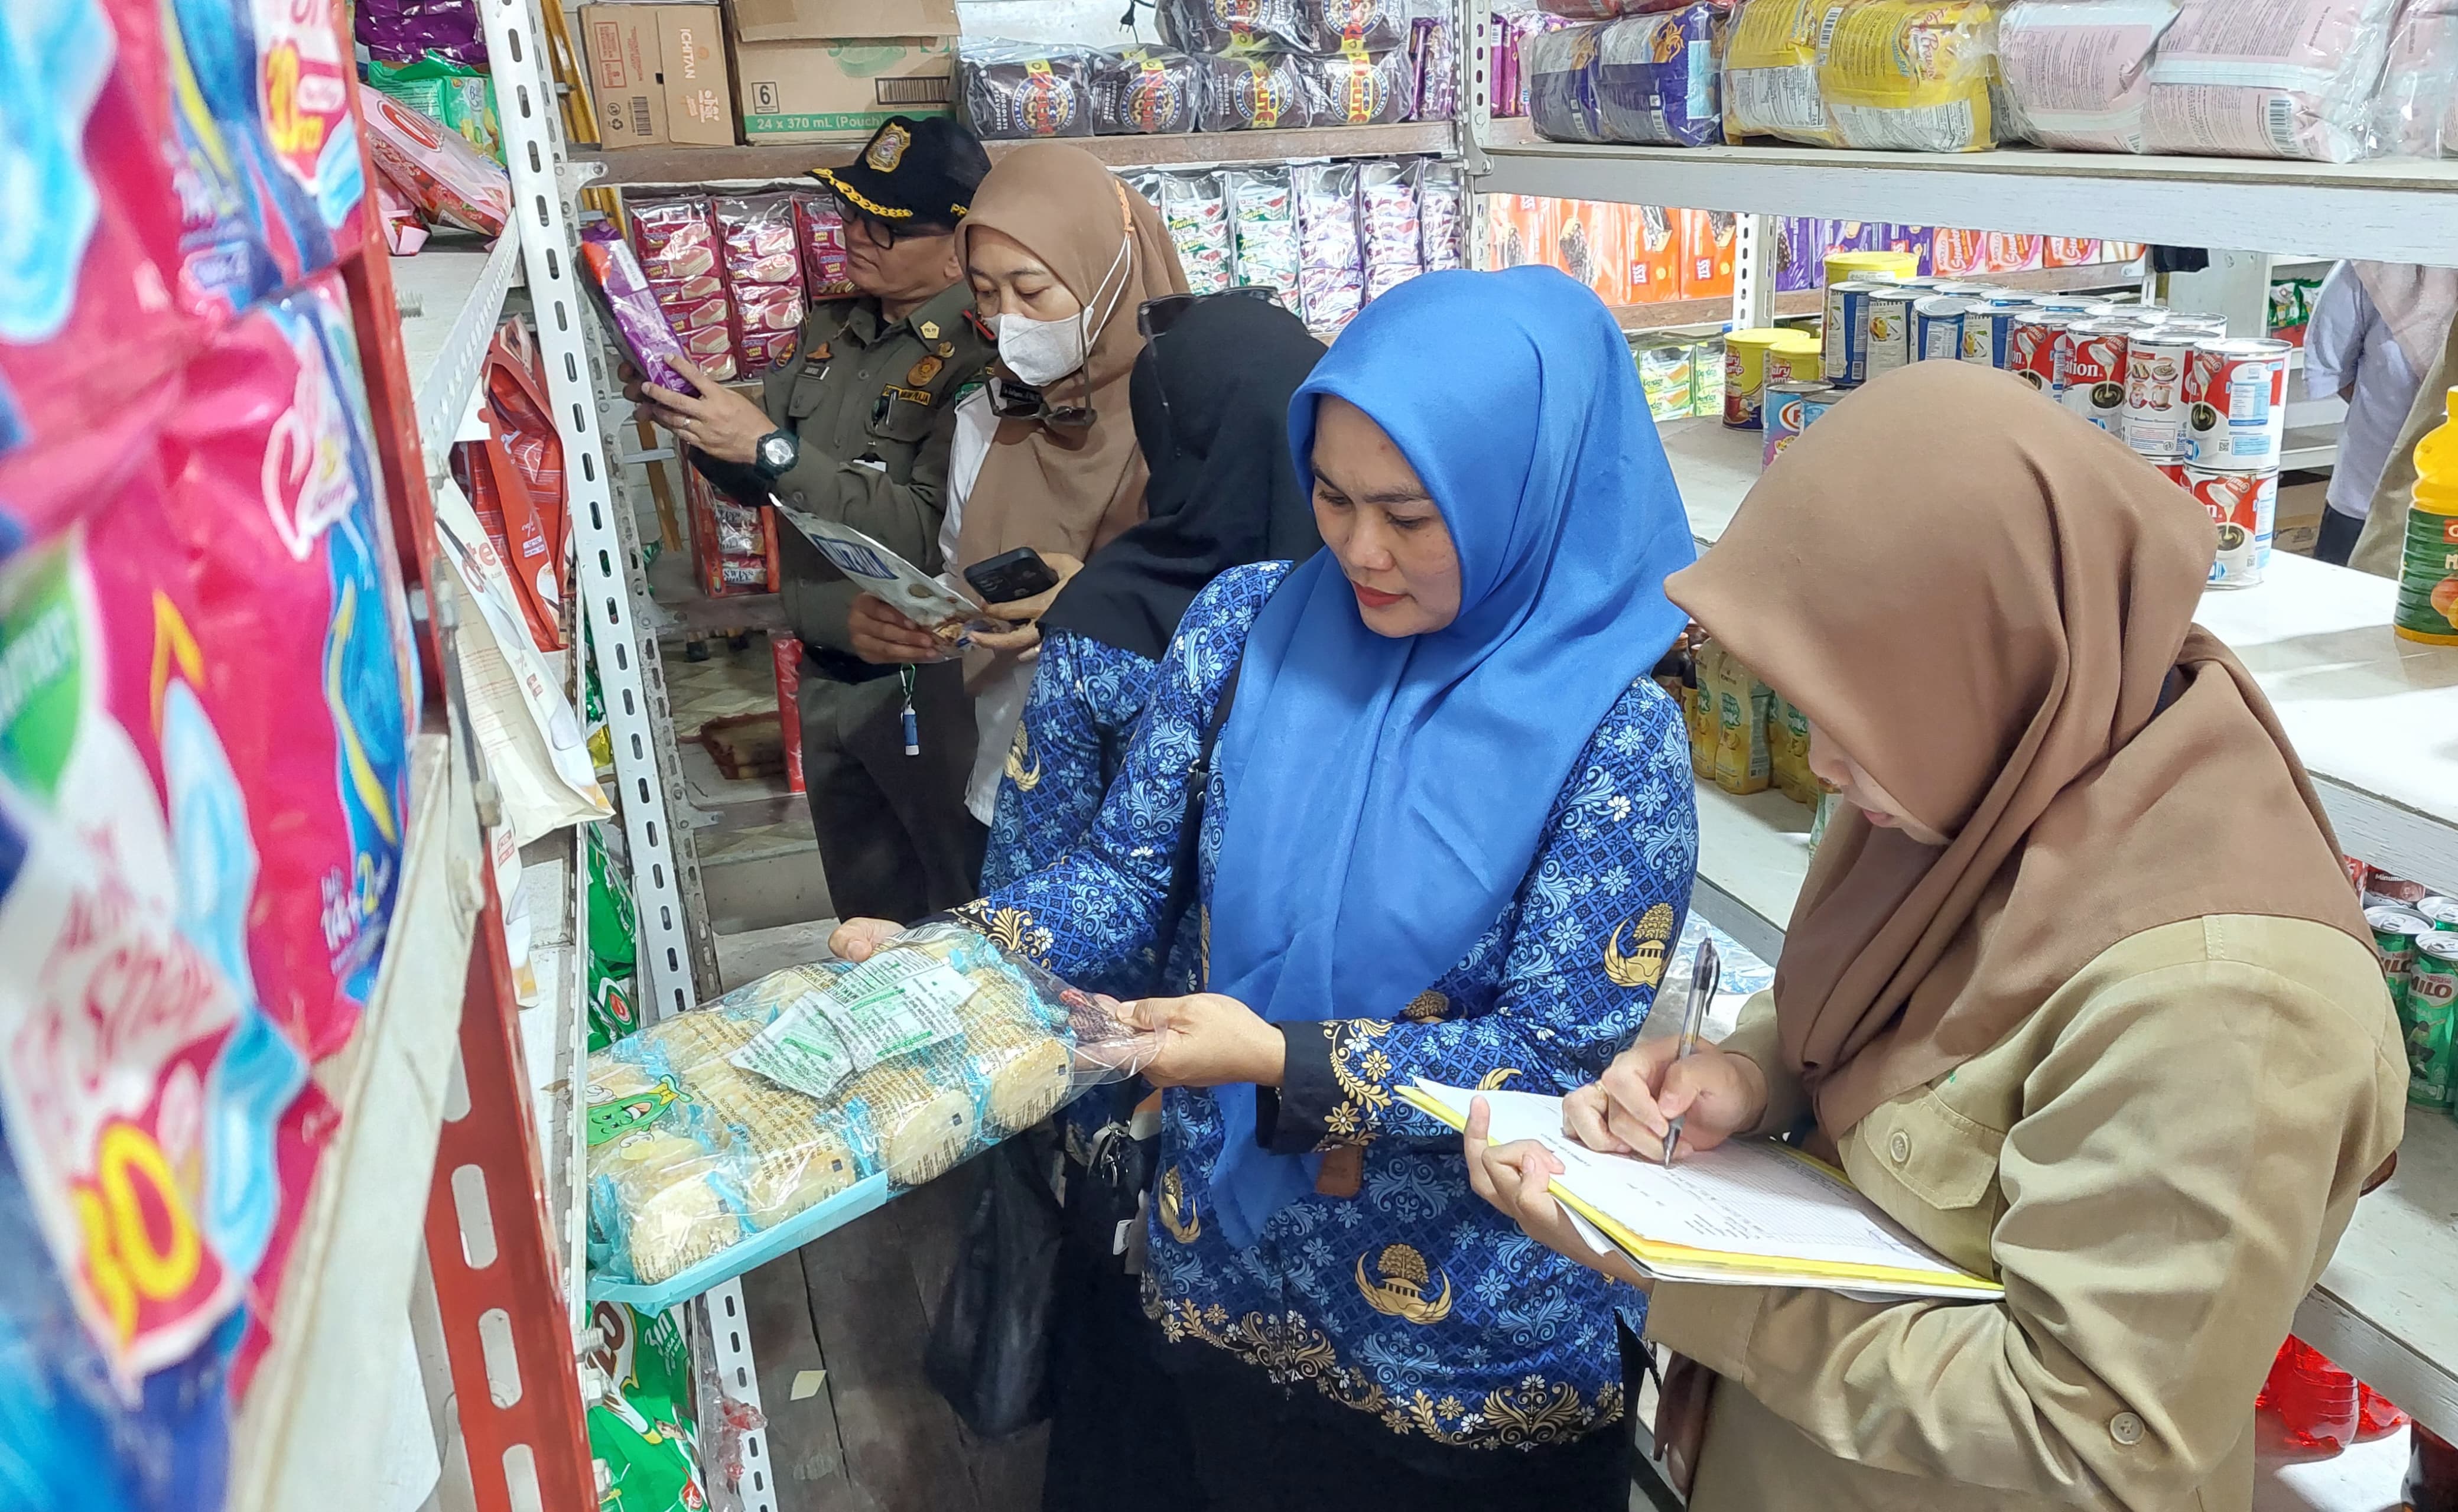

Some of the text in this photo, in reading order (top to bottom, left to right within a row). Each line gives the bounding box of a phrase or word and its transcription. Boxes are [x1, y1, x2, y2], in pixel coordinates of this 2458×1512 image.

[680, 28, 695, 79] ICHITAN
[760, 85, 771, 105] 6
[757, 119, 772, 129] 24
[788, 118, 809, 128] 370
[813, 116, 831, 127] mL
[836, 115, 885, 128] (Pouch)
[1939, 239, 1948, 267] APOLLO
[1632, 265, 1647, 285] ZESS
[1696, 258, 1711, 280] ZESS
[2064, 360, 2098, 378] ation
[818, 982, 851, 1004] NUTRITION
